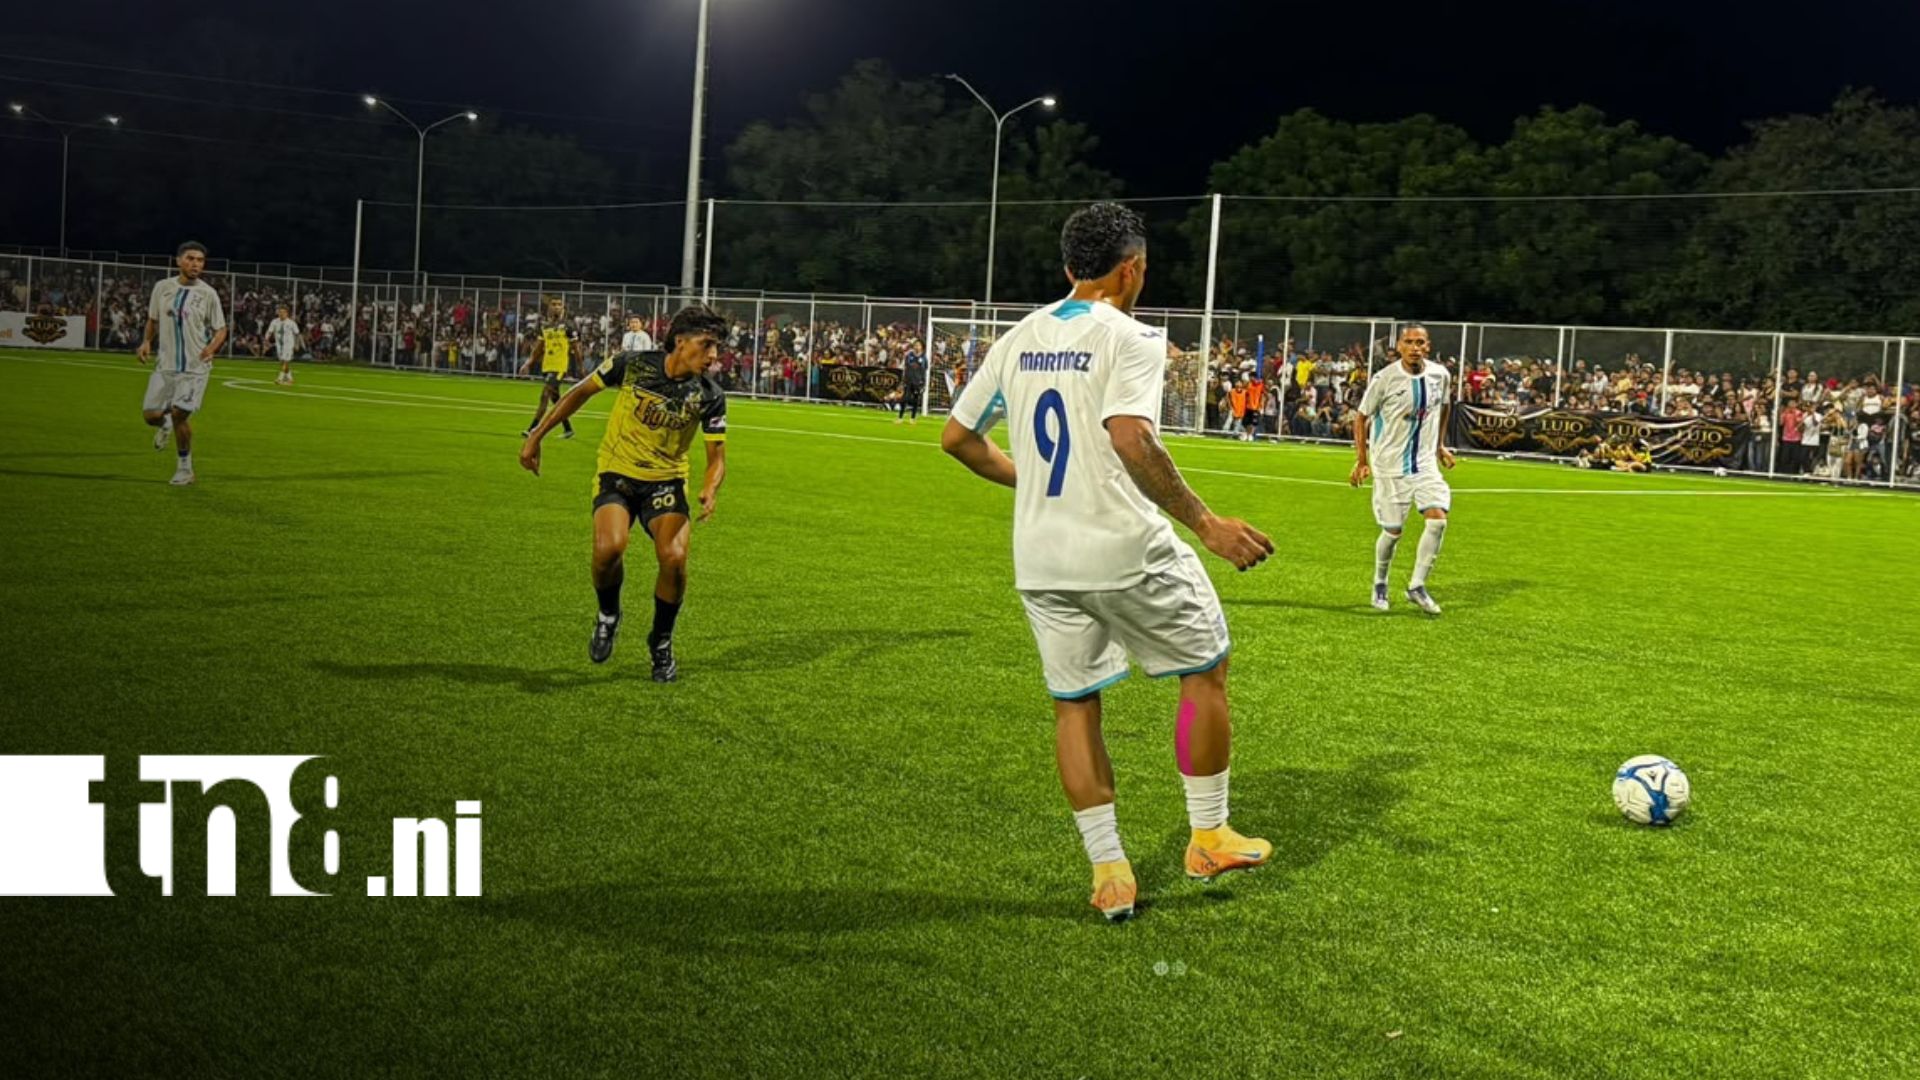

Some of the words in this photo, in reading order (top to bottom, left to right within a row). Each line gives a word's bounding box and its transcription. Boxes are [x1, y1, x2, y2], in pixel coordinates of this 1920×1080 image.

[1478, 415, 1517, 430] LUJO
[1541, 419, 1583, 433] LUJO
[1608, 423, 1651, 437] LUJO
[1034, 388, 1070, 497] 9
